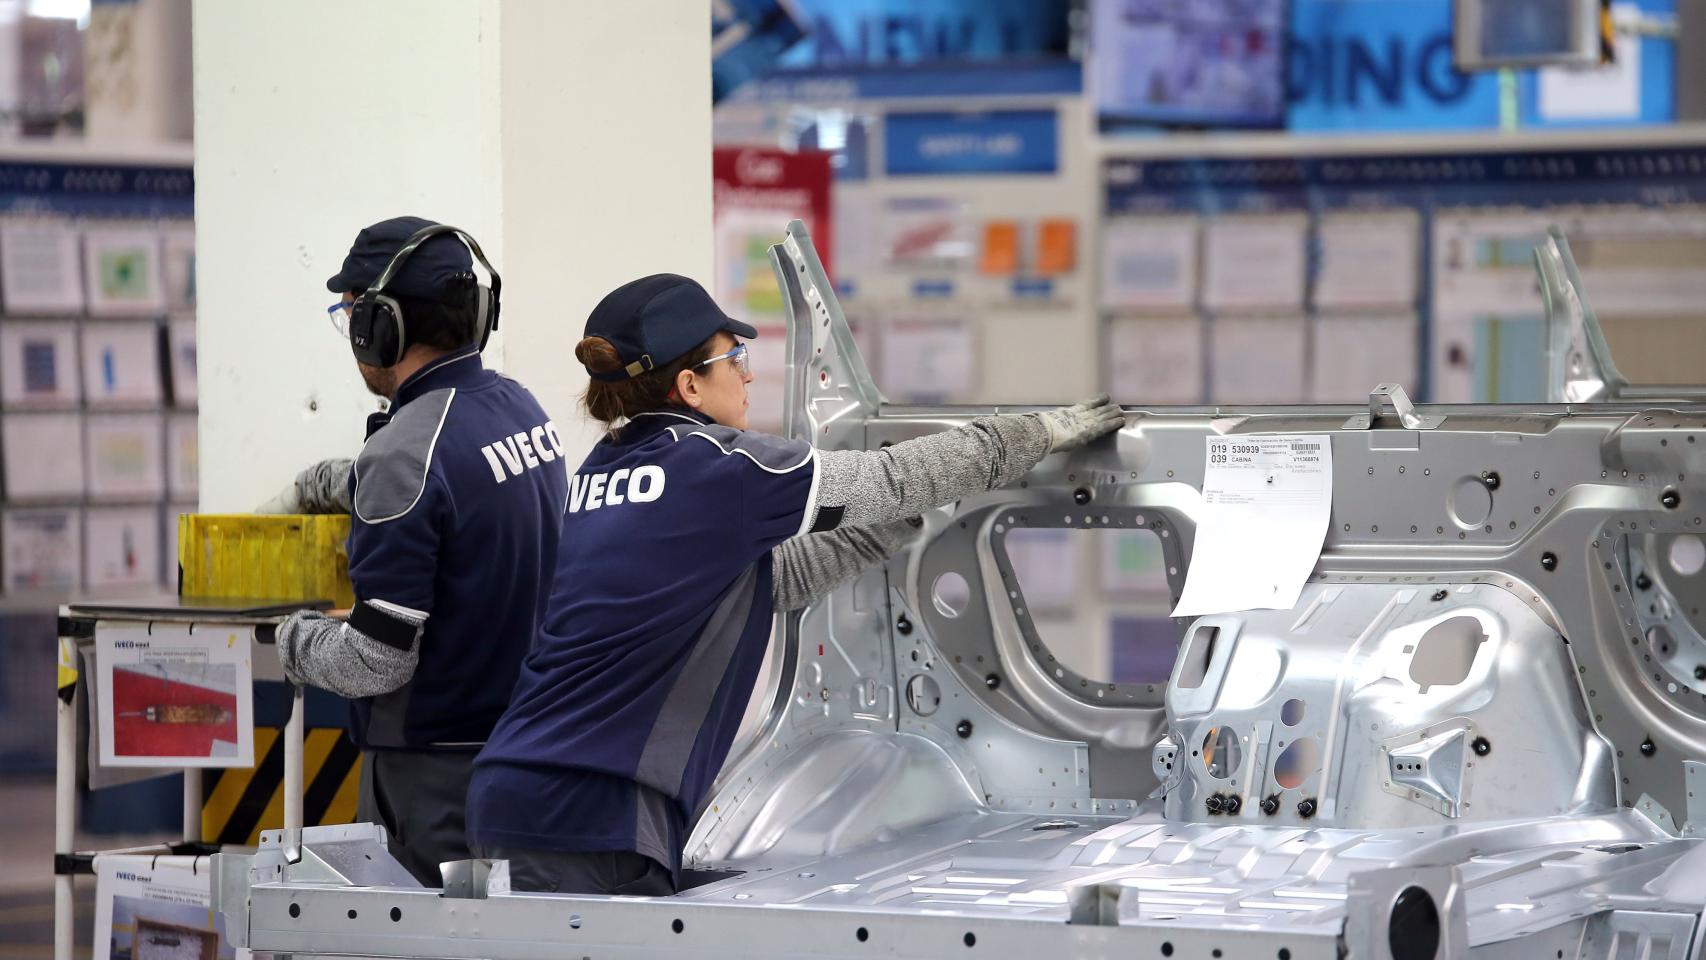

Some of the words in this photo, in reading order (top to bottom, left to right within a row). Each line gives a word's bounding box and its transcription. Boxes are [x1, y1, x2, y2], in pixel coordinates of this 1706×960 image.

[1211, 444, 1227, 453] 019
[1232, 445, 1260, 454] 530939
[1211, 454, 1227, 463] 039
[114, 640, 134, 649] IVECO
[116, 872, 136, 882] IVECO
